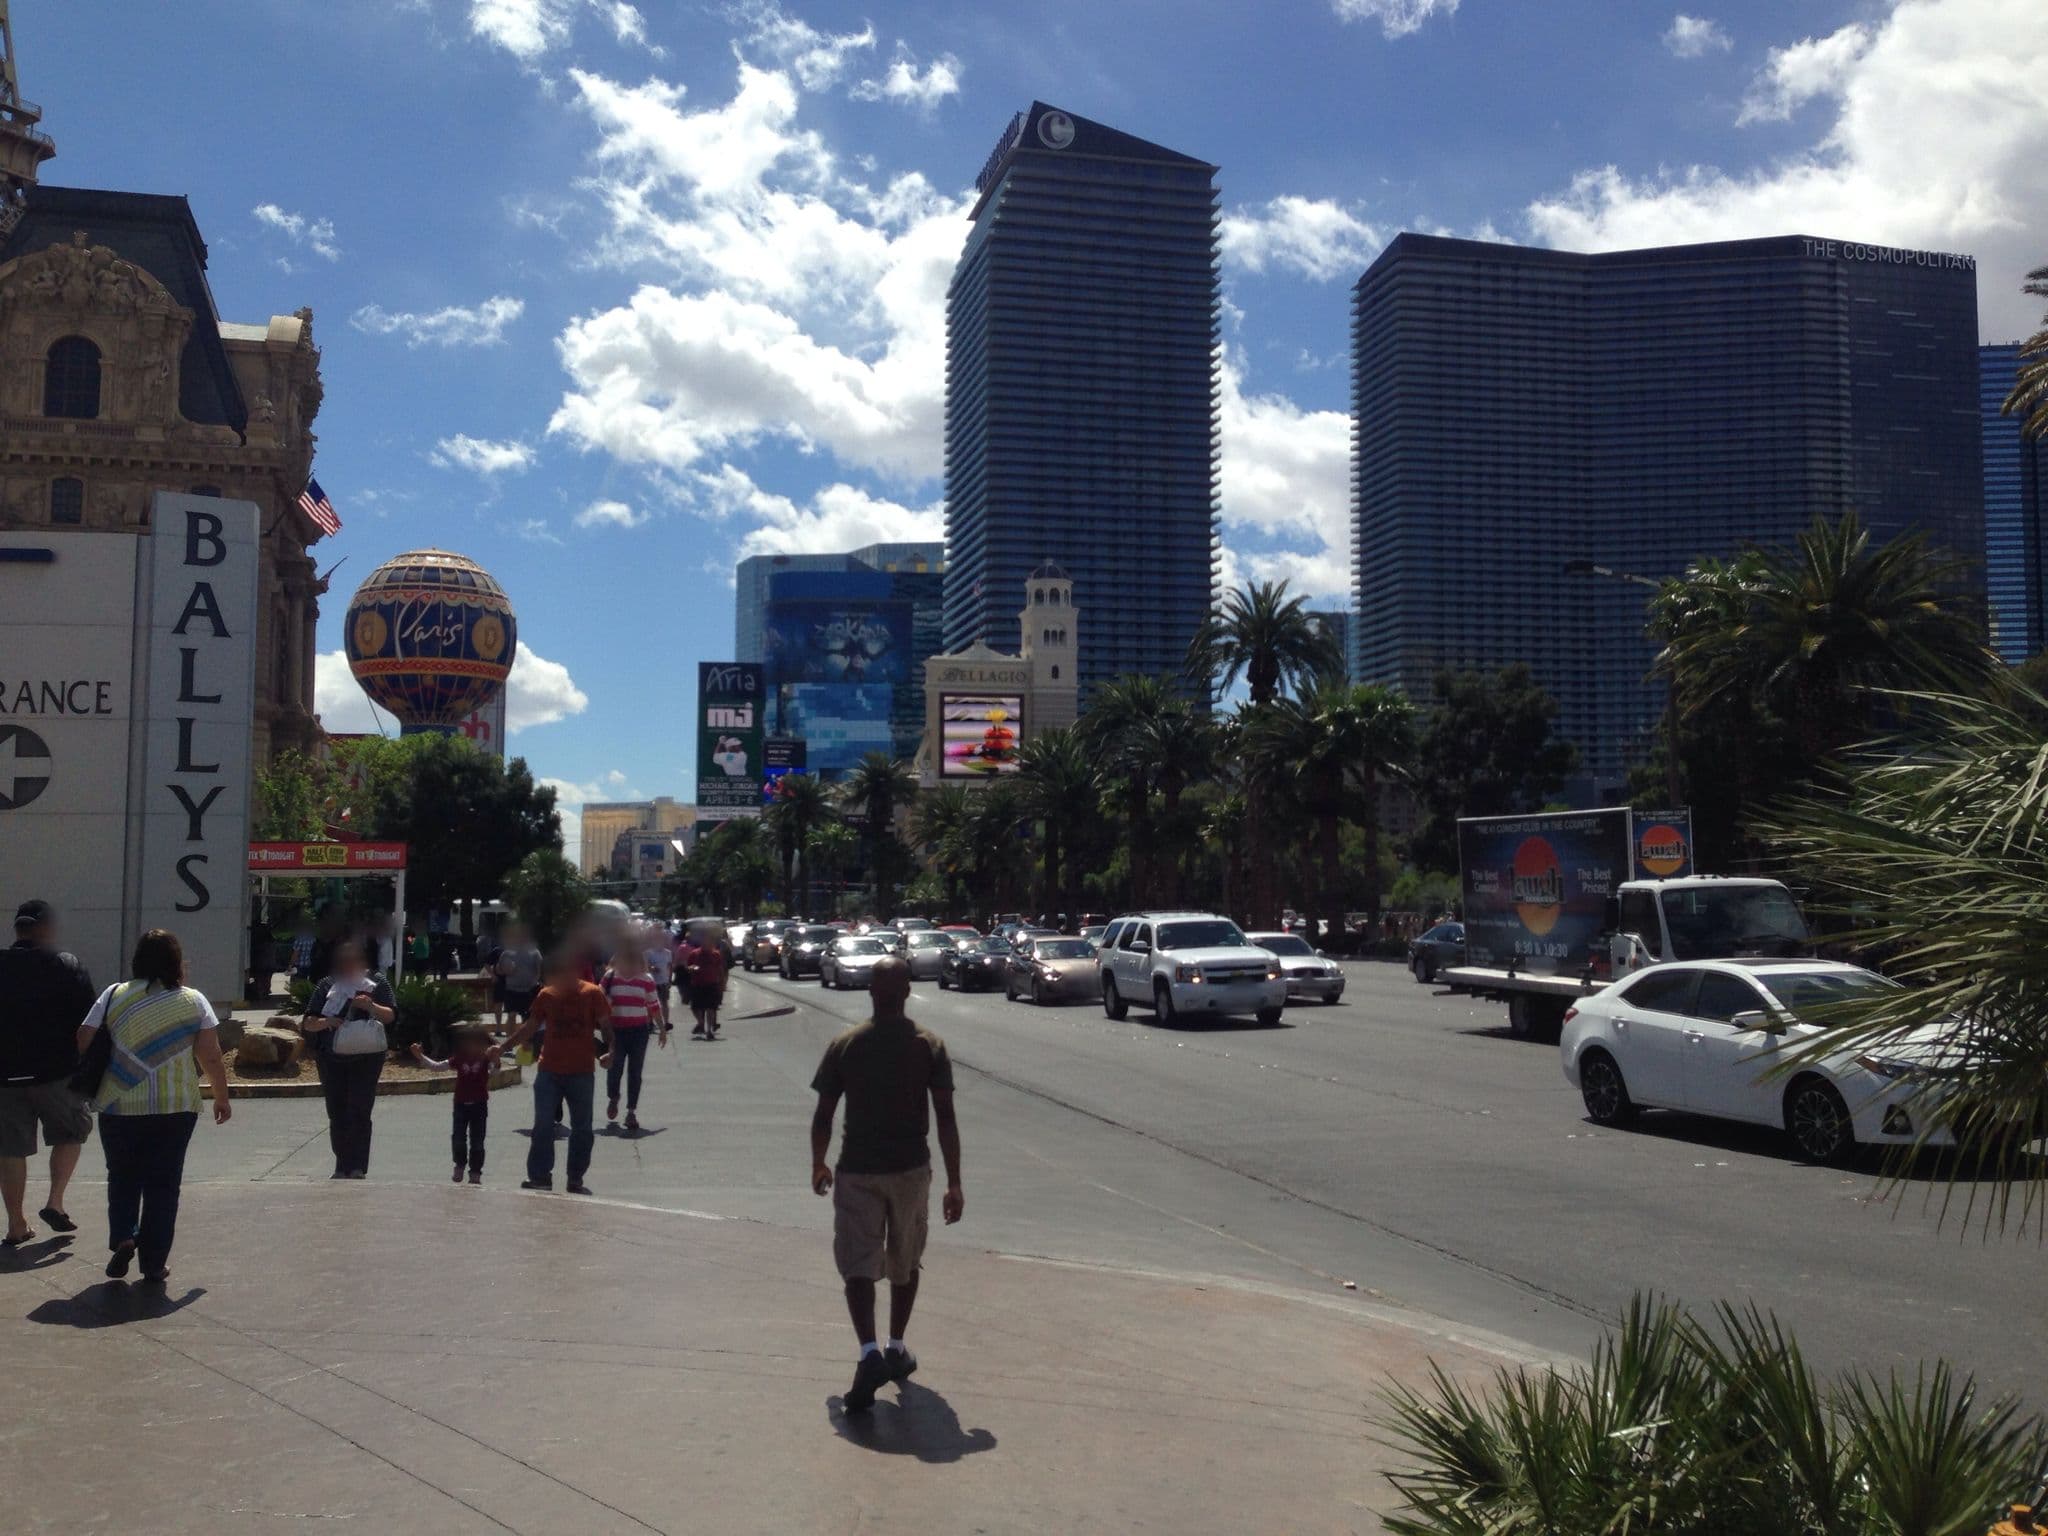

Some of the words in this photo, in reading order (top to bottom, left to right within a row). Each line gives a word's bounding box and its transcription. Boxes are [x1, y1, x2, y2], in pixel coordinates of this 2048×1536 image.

[1803, 239, 1837, 258] THE
[1843, 242, 1975, 271] COSMOPOLITAN
[395, 590, 464, 662] Paris
[942, 667, 1027, 682] BELLAGIO
[166, 510, 232, 913] BALLYS
[1577, 868, 1592, 880] The
[1593, 868, 1612, 880] Best
[1544, 943, 1568, 957] 10:30
